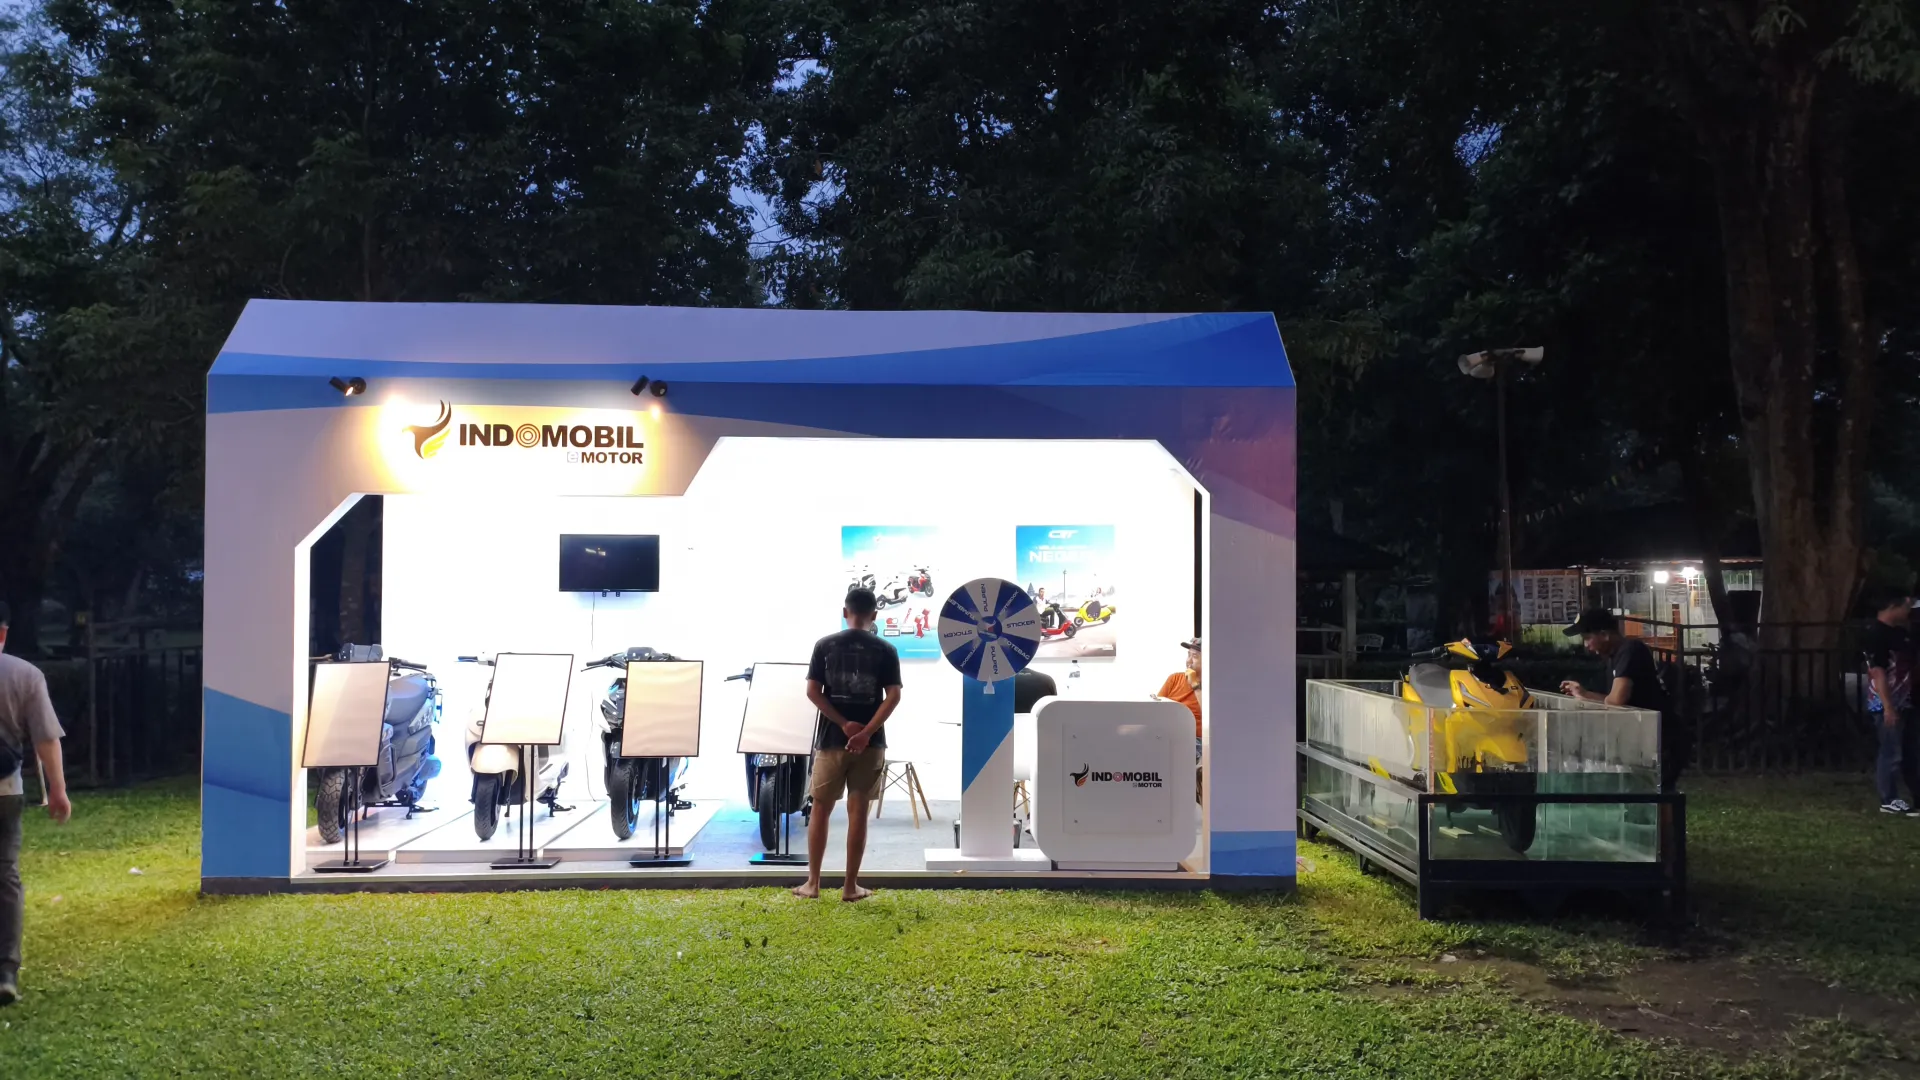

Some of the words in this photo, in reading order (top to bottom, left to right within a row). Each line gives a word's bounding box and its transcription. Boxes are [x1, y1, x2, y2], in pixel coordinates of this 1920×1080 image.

[460, 423, 644, 448] INDOMOBIL
[581, 451, 643, 464] MOTOR
[1007, 620, 1035, 628] STICKER
[943, 630, 972, 639] STICKER
[1091, 771, 1162, 782] INDOMOBIL
